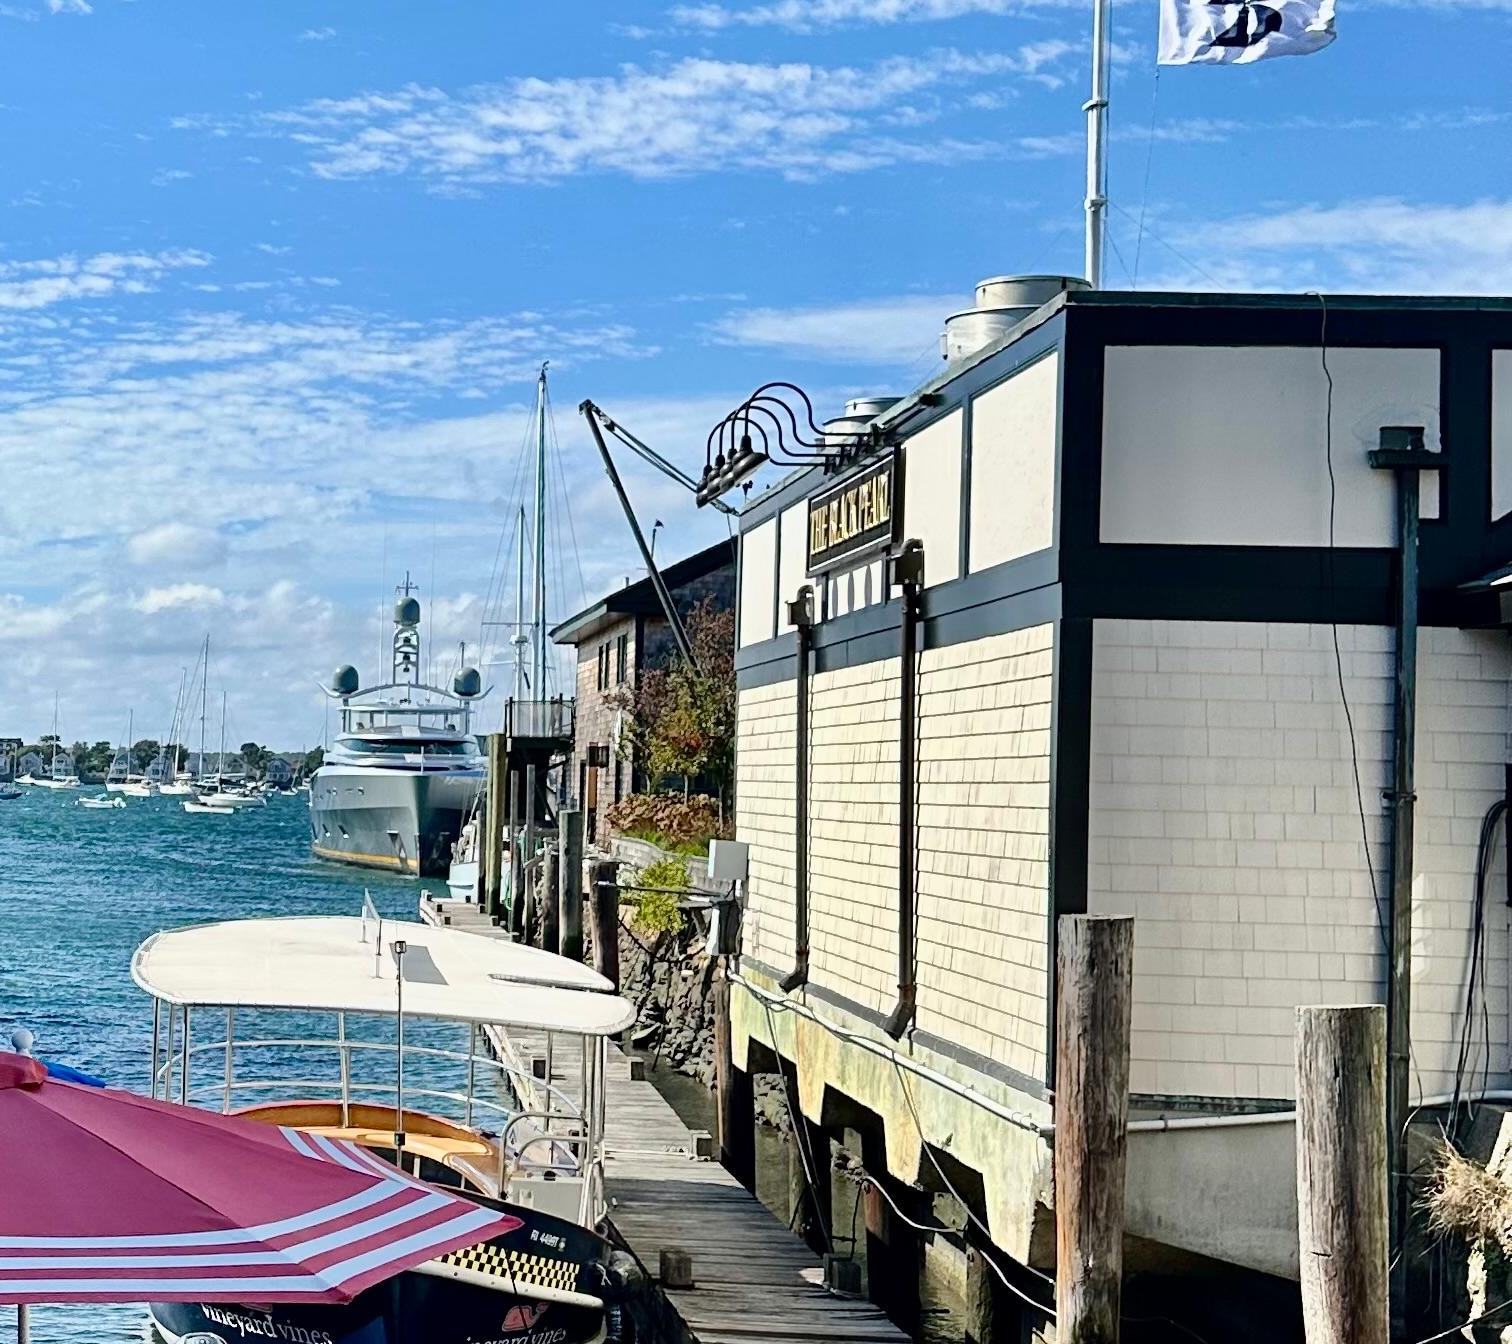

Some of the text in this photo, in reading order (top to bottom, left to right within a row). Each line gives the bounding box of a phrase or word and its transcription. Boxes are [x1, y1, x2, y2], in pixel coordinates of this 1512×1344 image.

[810, 470, 891, 555] THE BLACK PEARL
[201, 1303, 278, 1338] vineyard
